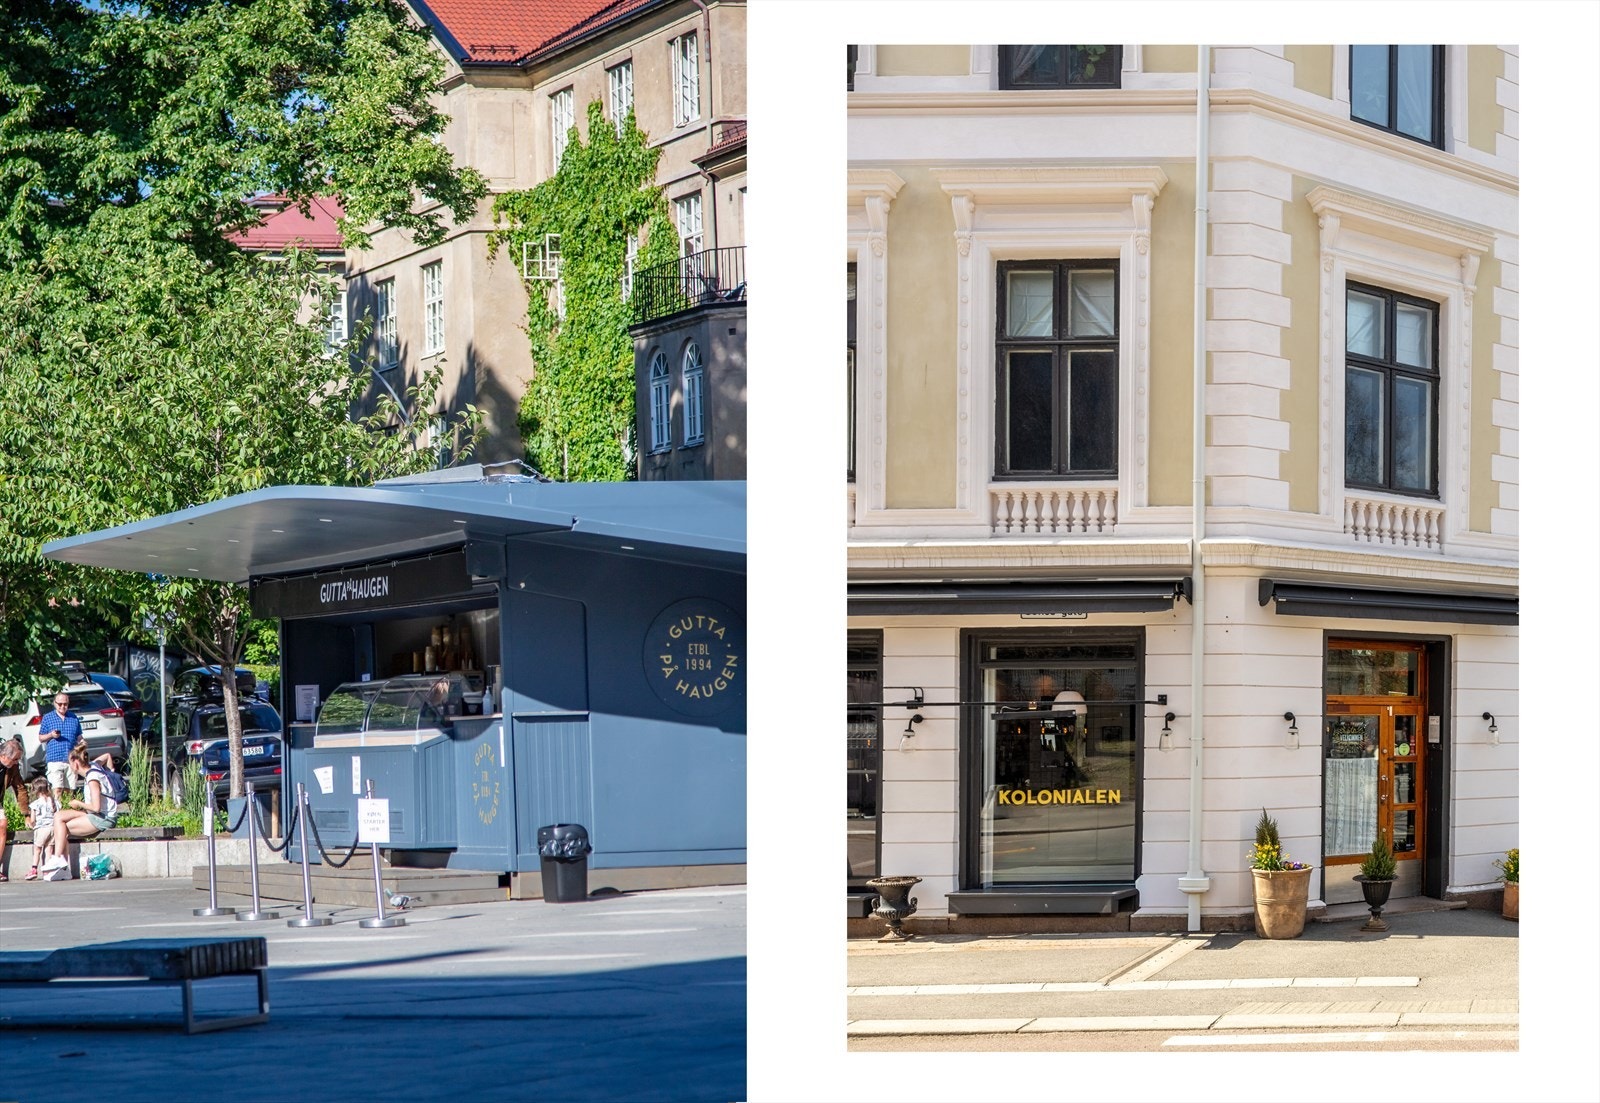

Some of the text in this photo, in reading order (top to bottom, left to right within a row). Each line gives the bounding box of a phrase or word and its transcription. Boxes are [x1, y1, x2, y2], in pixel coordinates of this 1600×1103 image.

[320, 581, 347, 603] GUTTA
[352, 576, 389, 600] HAUGEN
[660, 615, 738, 699] GUTTA PÅ HAUGEN
[688, 643, 710, 655] ETBL
[685, 658, 712, 671] 1994
[474, 743, 495, 767] GUTTA
[478, 782, 500, 825] HAUGEN
[998, 789, 1121, 805] KOLONIALEN
